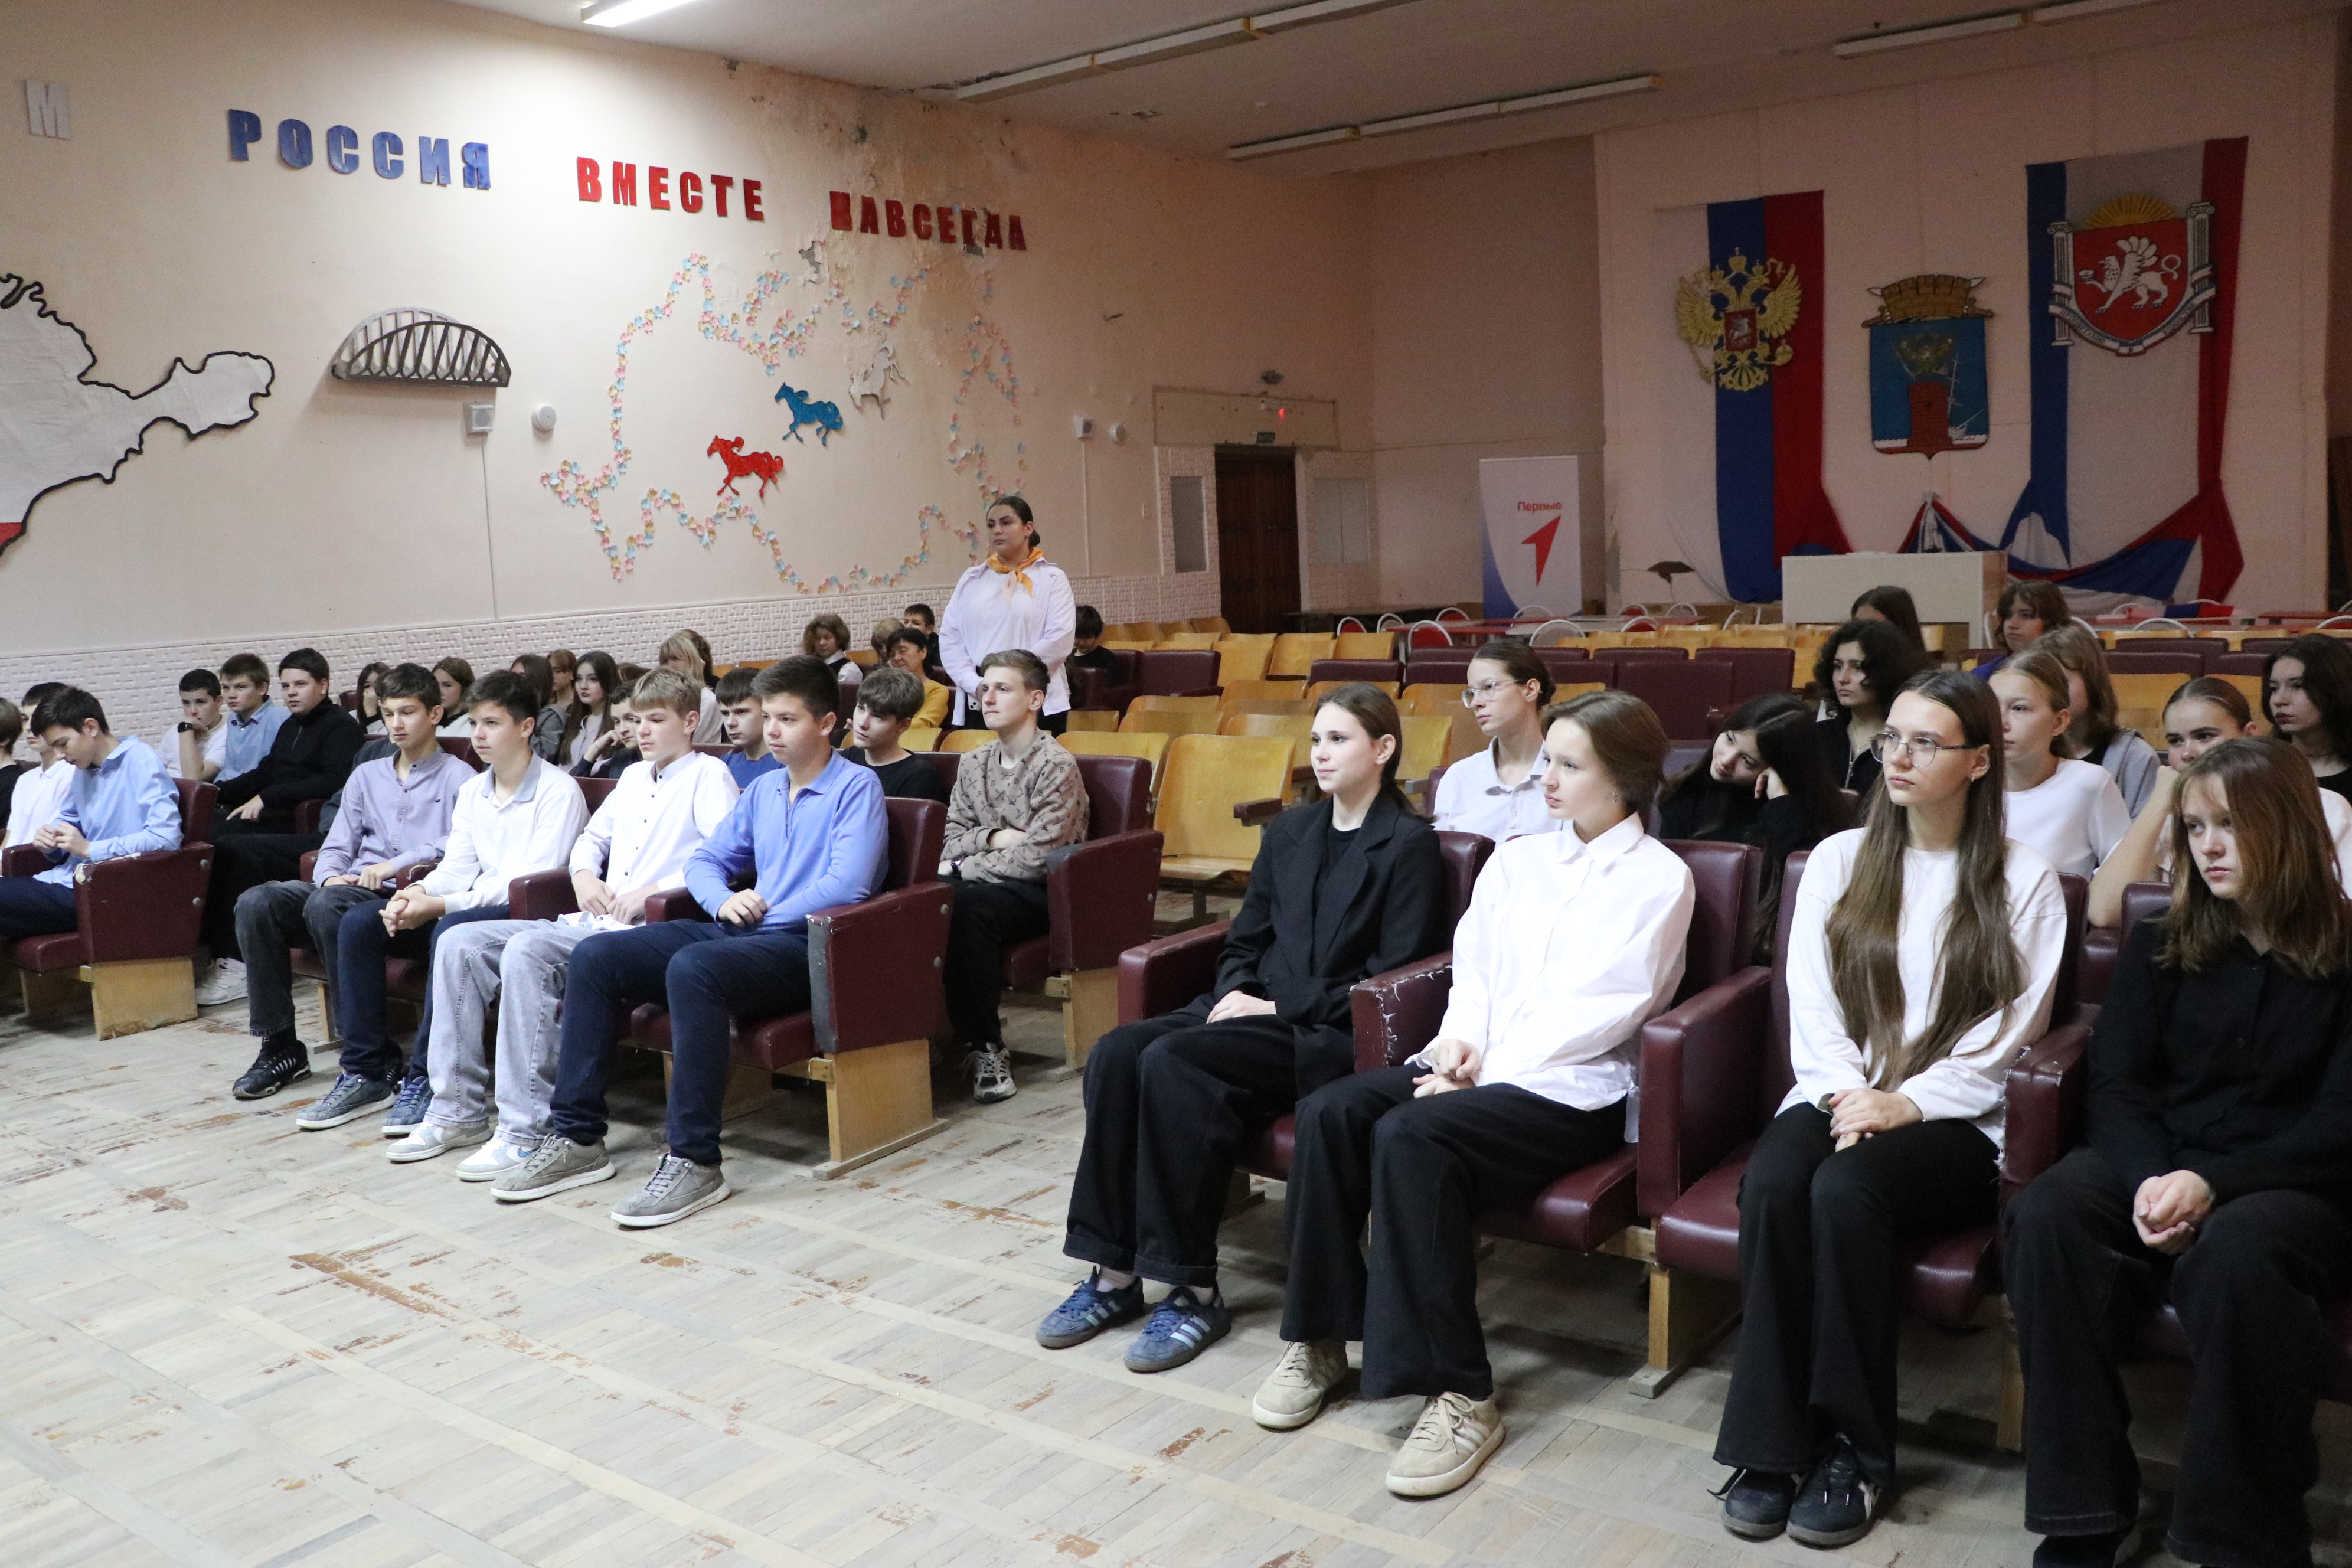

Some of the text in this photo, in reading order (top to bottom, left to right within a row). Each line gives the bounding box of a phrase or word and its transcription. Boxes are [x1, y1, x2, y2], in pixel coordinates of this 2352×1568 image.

[228, 109, 492, 190] РОССИЯ
[576, 156, 764, 222] ВМЕСТЕ
[1517, 501, 1562, 513] Первые
